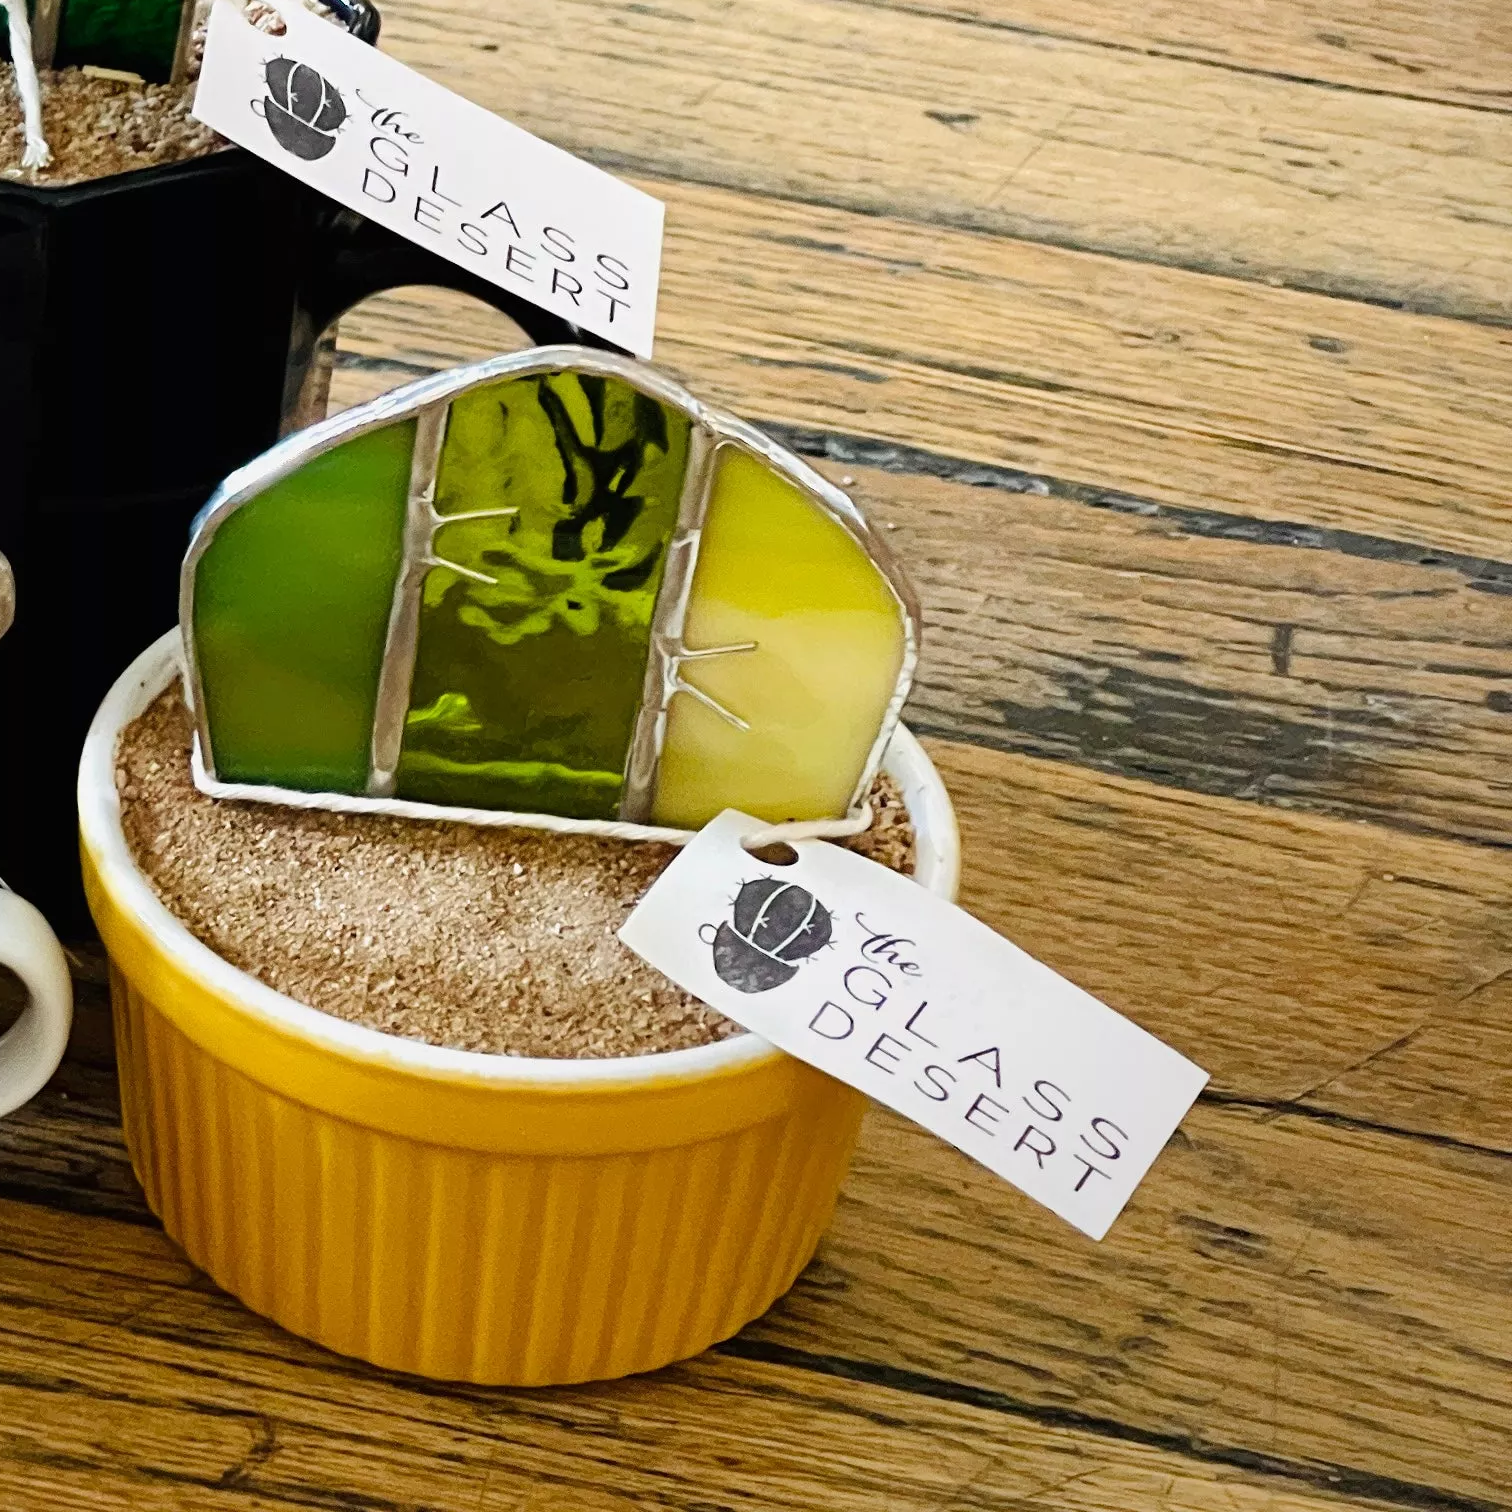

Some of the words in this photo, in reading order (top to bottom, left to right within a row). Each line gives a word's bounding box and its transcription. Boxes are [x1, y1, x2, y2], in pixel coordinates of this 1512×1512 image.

[355, 89, 425, 145] the
[361, 168, 632, 323] DESERT
[370, 136, 630, 291] GLASS
[854, 912, 924, 978] the
[807, 1000, 1113, 1193] DESERT
[843, 965, 1129, 1161] GLASS
